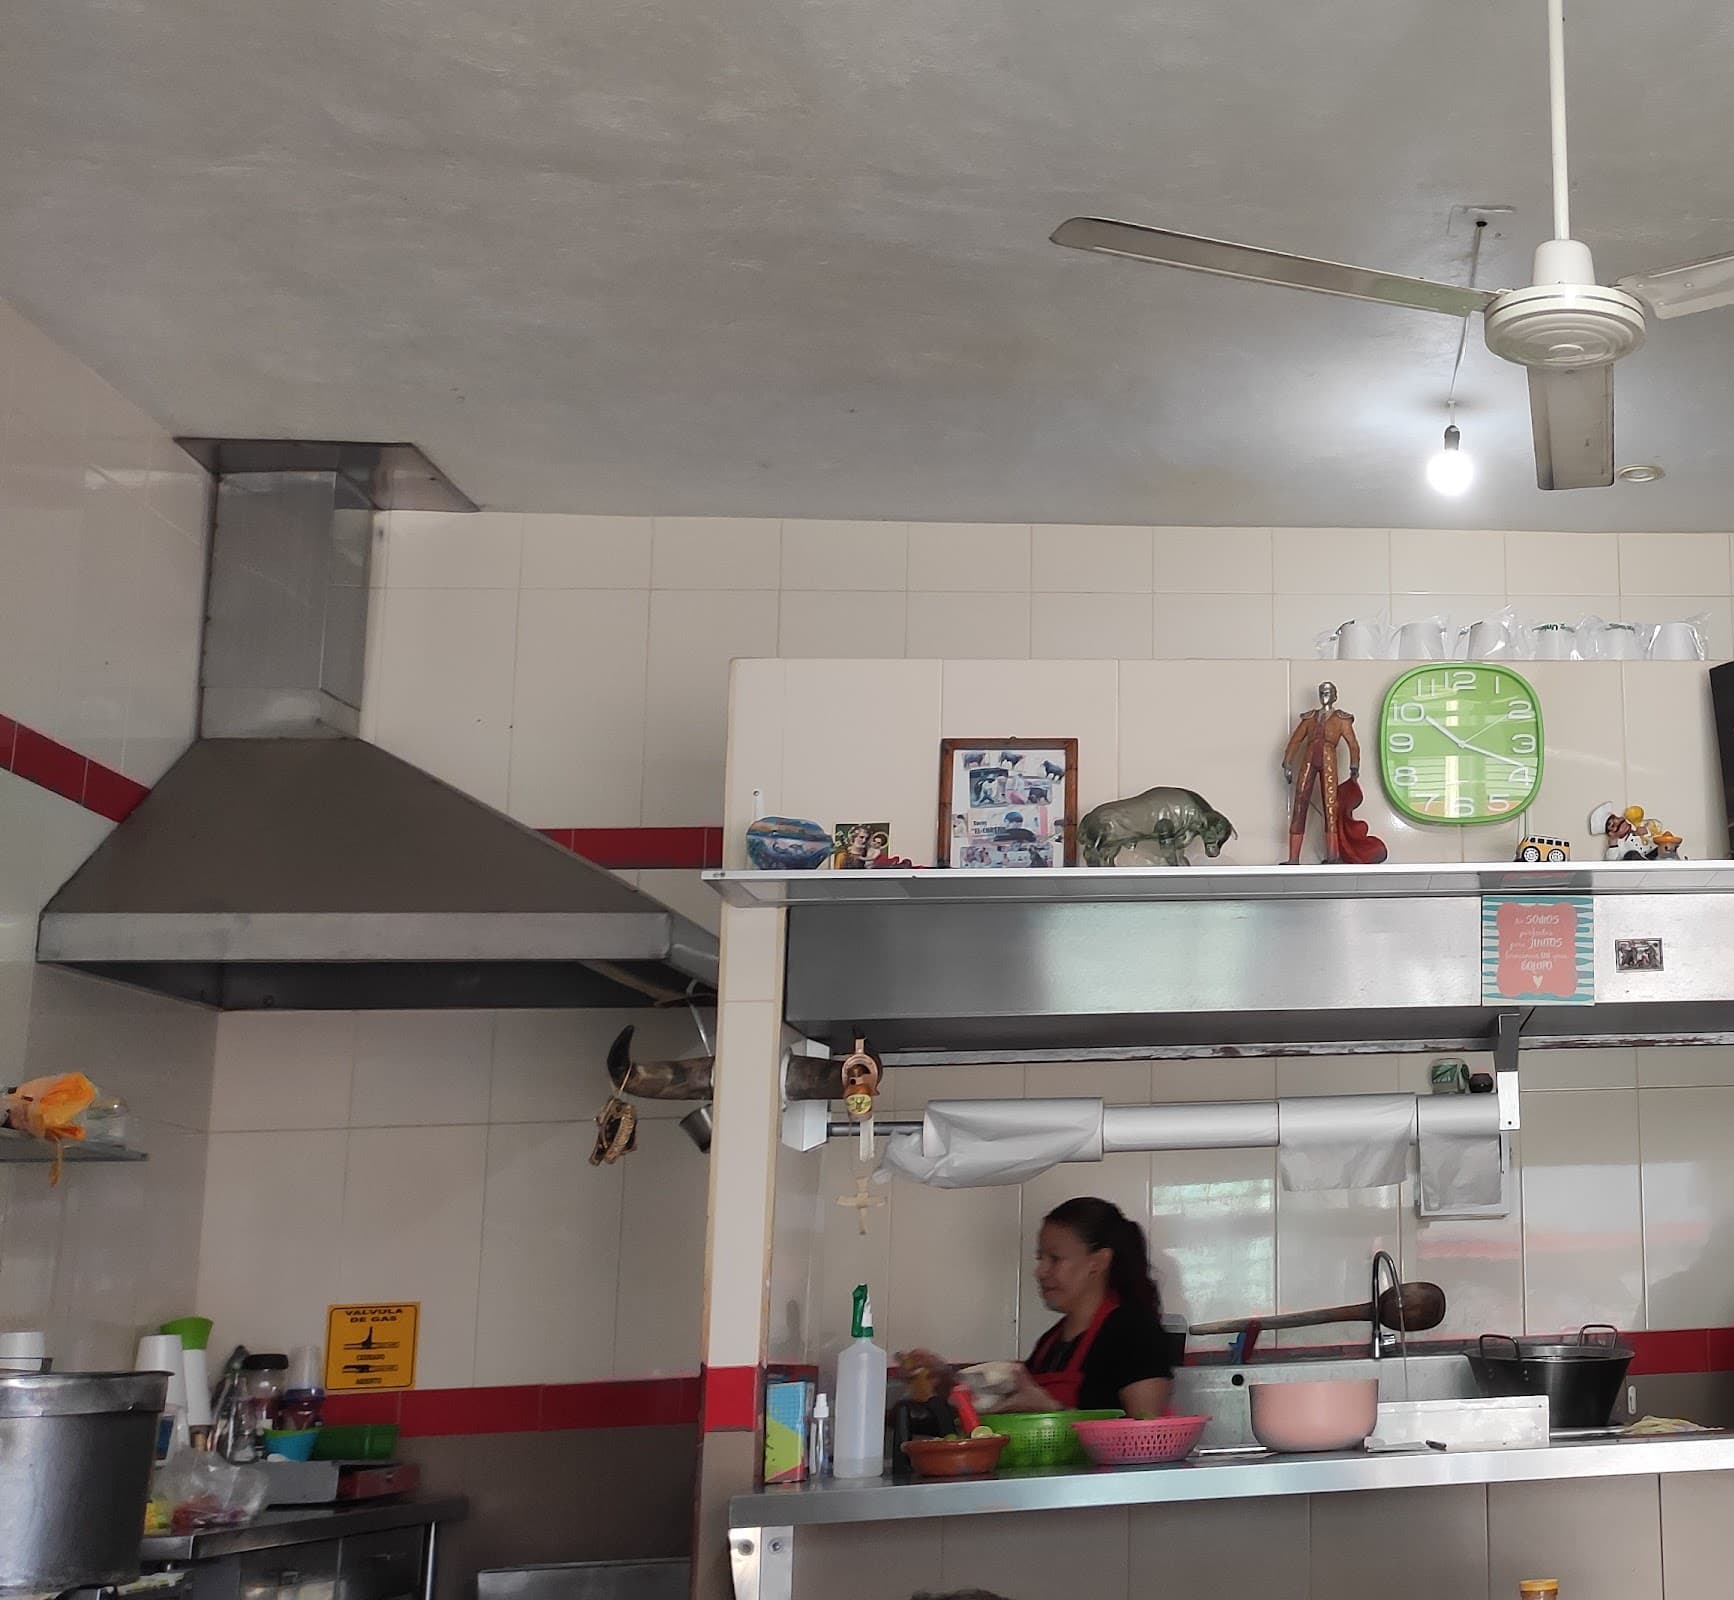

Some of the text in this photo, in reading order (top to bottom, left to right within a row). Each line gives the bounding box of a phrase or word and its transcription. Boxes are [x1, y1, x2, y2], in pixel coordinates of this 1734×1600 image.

[1417, 678, 1435, 697] 11
[1444, 671, 1476, 690] 12
[1495, 675, 1500, 695] 1
[1392, 702, 1425, 722] 10
[1508, 700, 1535, 720] 2
[1388, 732, 1414, 753] 9
[1511, 733, 1536, 754] 3
[1393, 766, 1418, 786] 8
[1508, 766, 1533, 786] 4
[1415, 792, 1440, 812] 7
[1454, 796, 1475, 817] 6
[1487, 793, 1510, 812] 5
